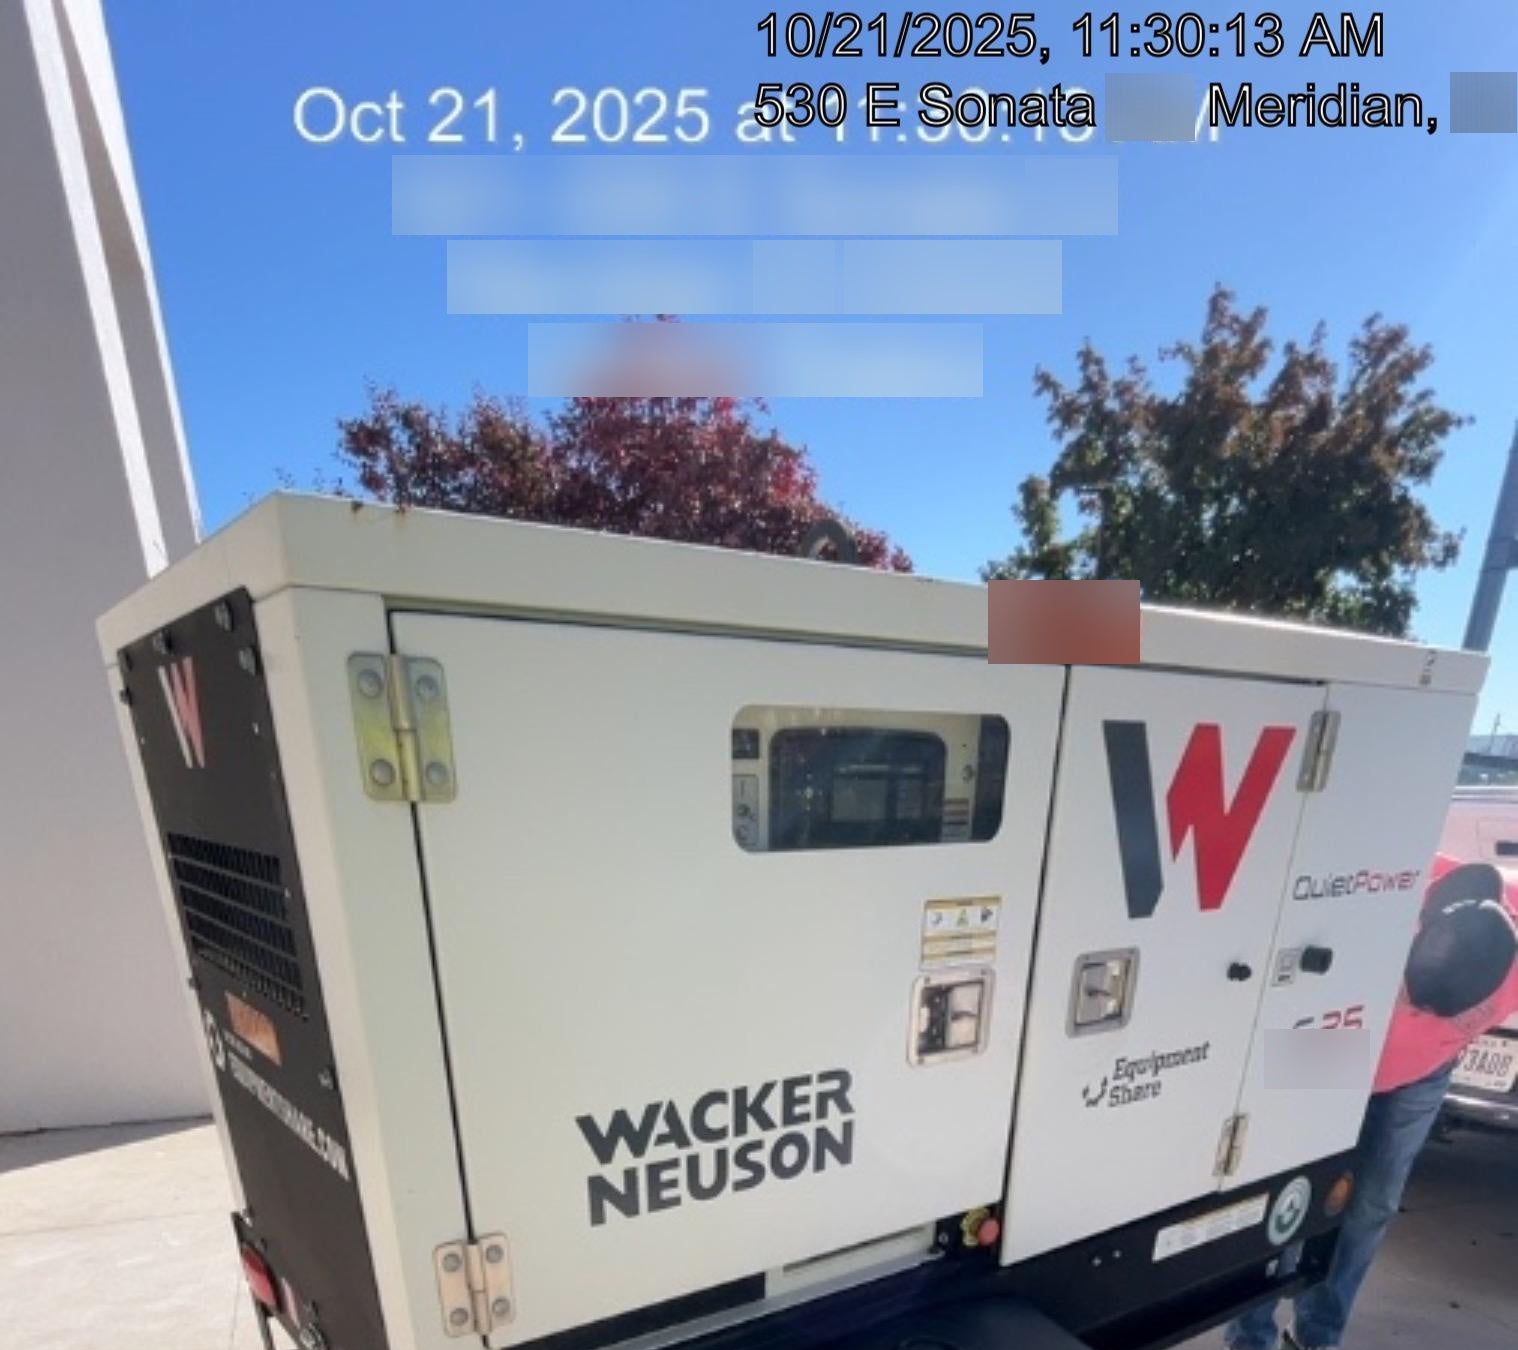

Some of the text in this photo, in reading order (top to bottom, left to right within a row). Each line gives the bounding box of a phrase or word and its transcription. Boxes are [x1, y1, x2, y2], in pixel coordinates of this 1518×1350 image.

[1292, 869, 1420, 901] QuietPower
[1112, 1040, 1210, 1082] Equipment
[1108, 1079, 1162, 1108] Share
[575, 1067, 855, 1165] WACKER
[587, 1119, 854, 1227] NEUSON
